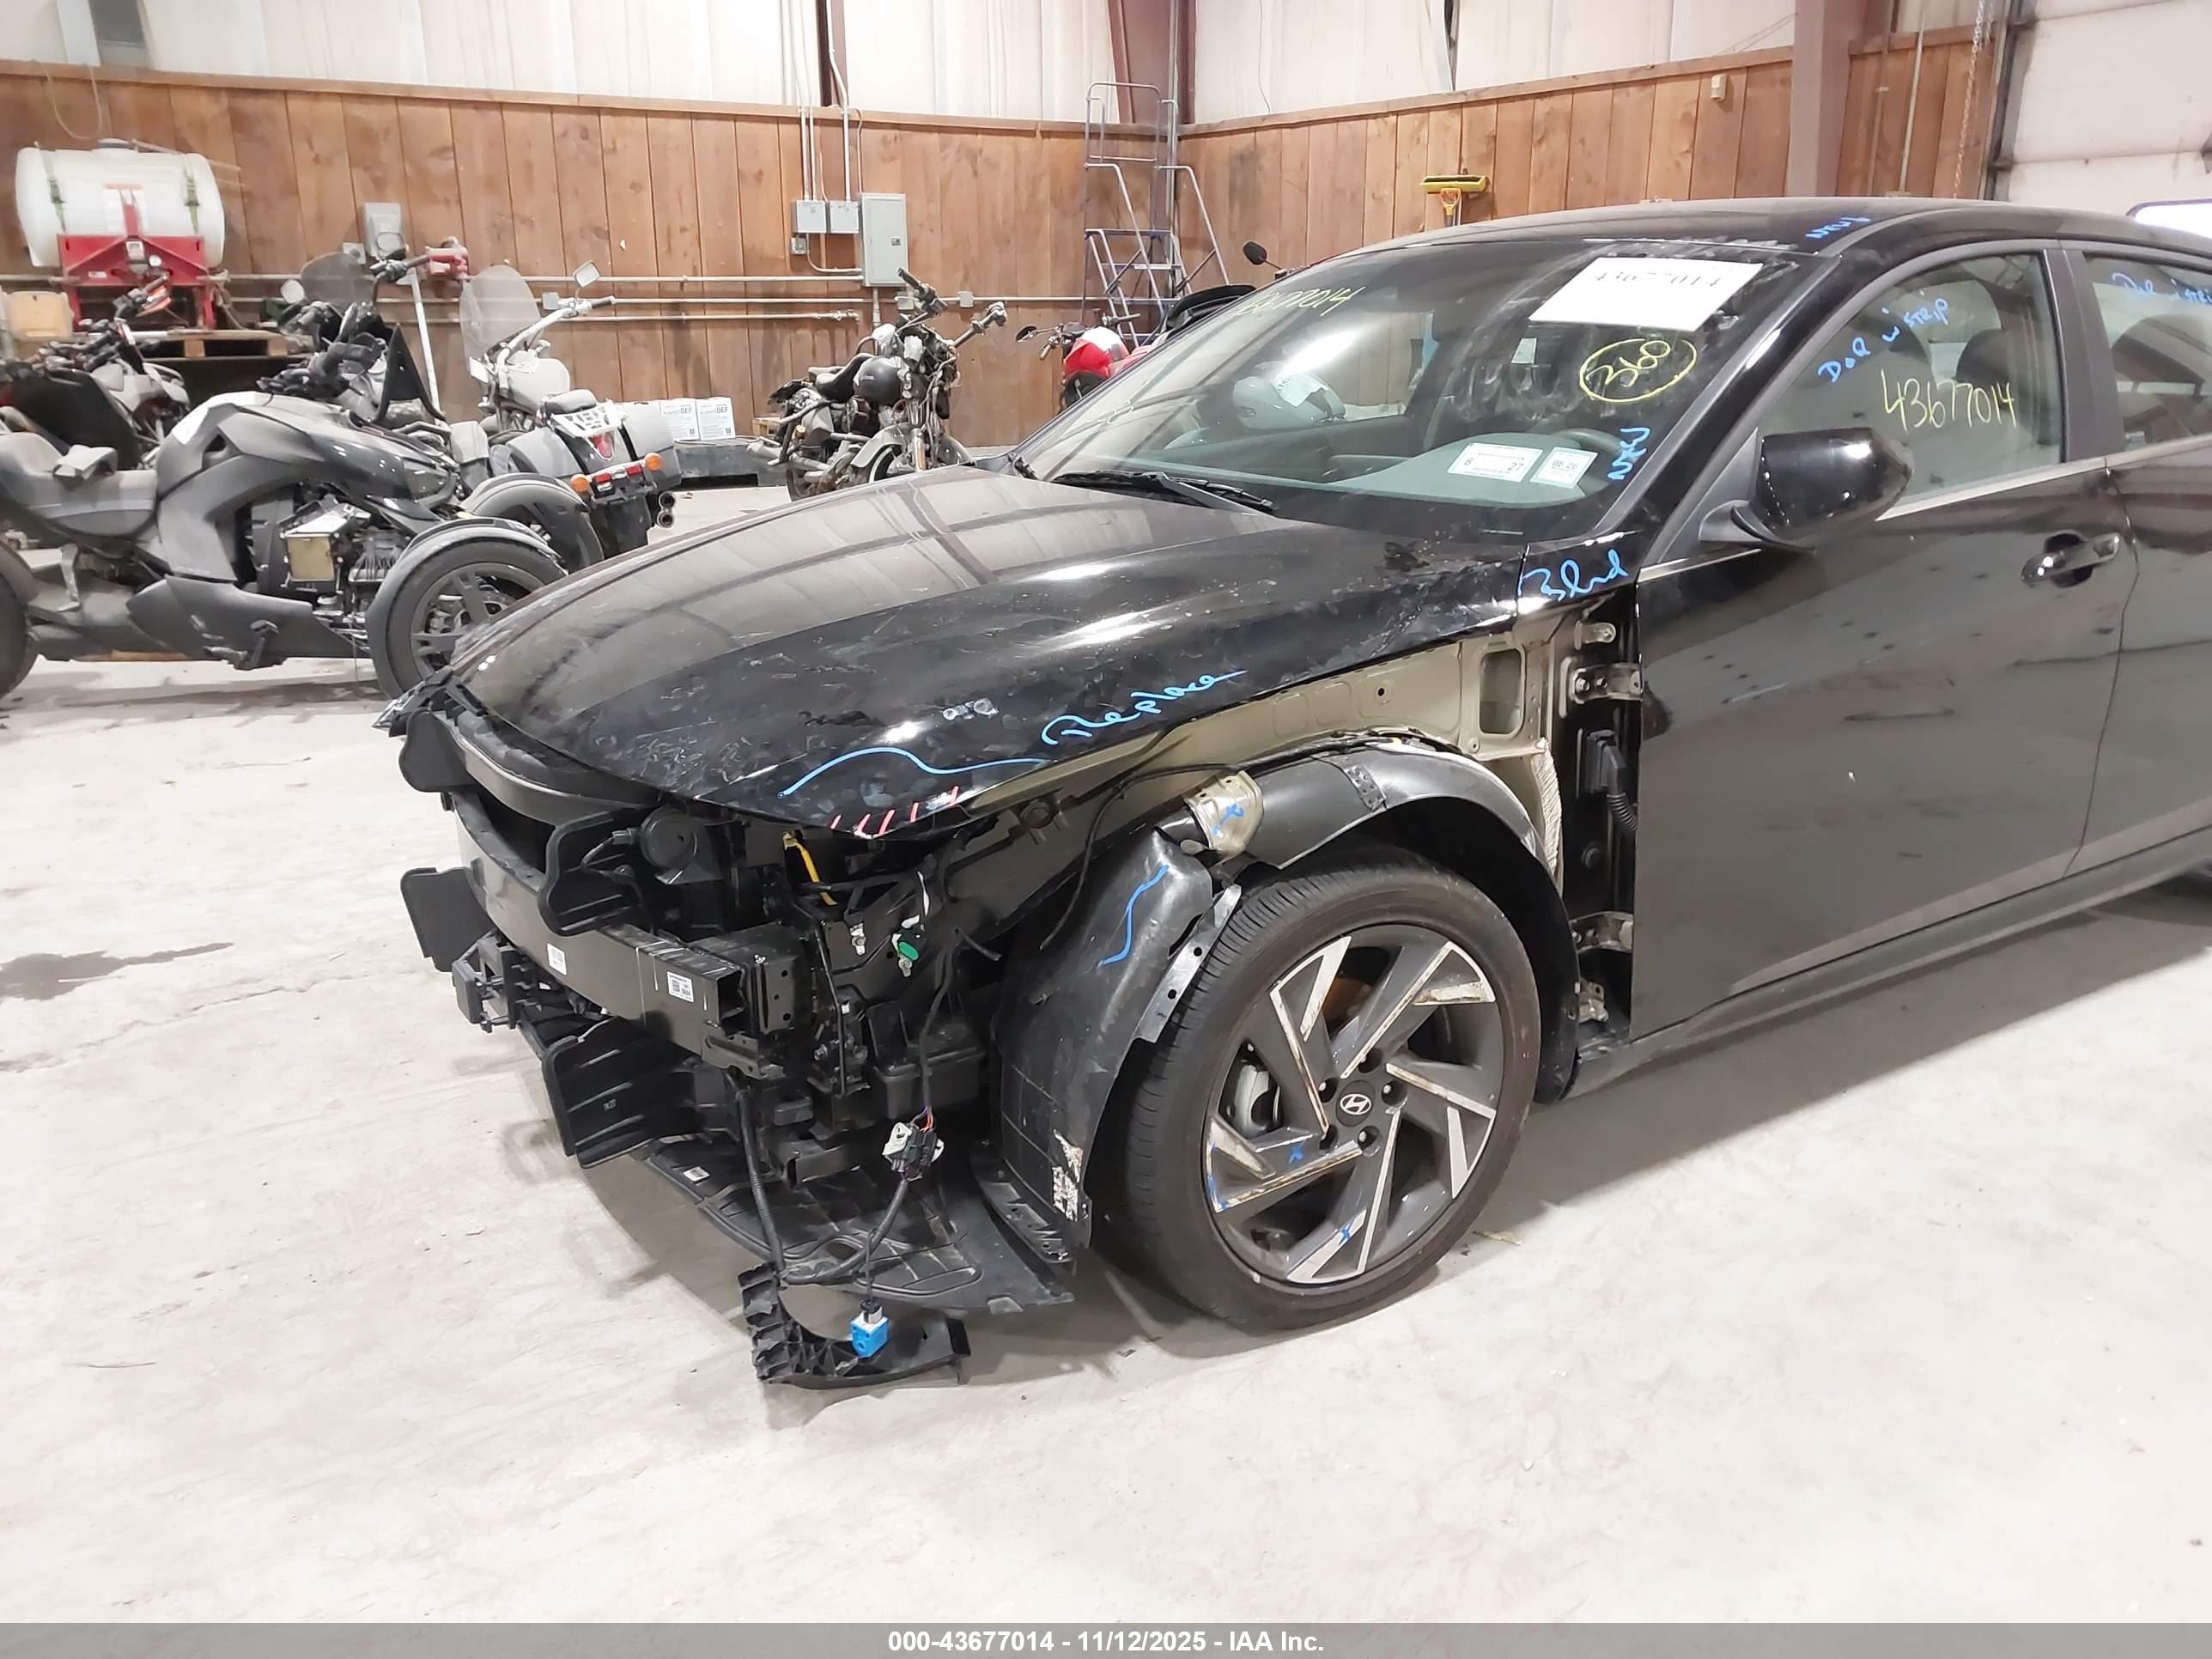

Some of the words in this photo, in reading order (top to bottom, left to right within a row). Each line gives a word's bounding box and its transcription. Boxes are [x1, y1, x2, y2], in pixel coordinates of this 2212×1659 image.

[1586, 340, 1671, 387] 360
[1881, 368, 2017, 434] 43677014
[1507, 461, 1525, 471] 27
